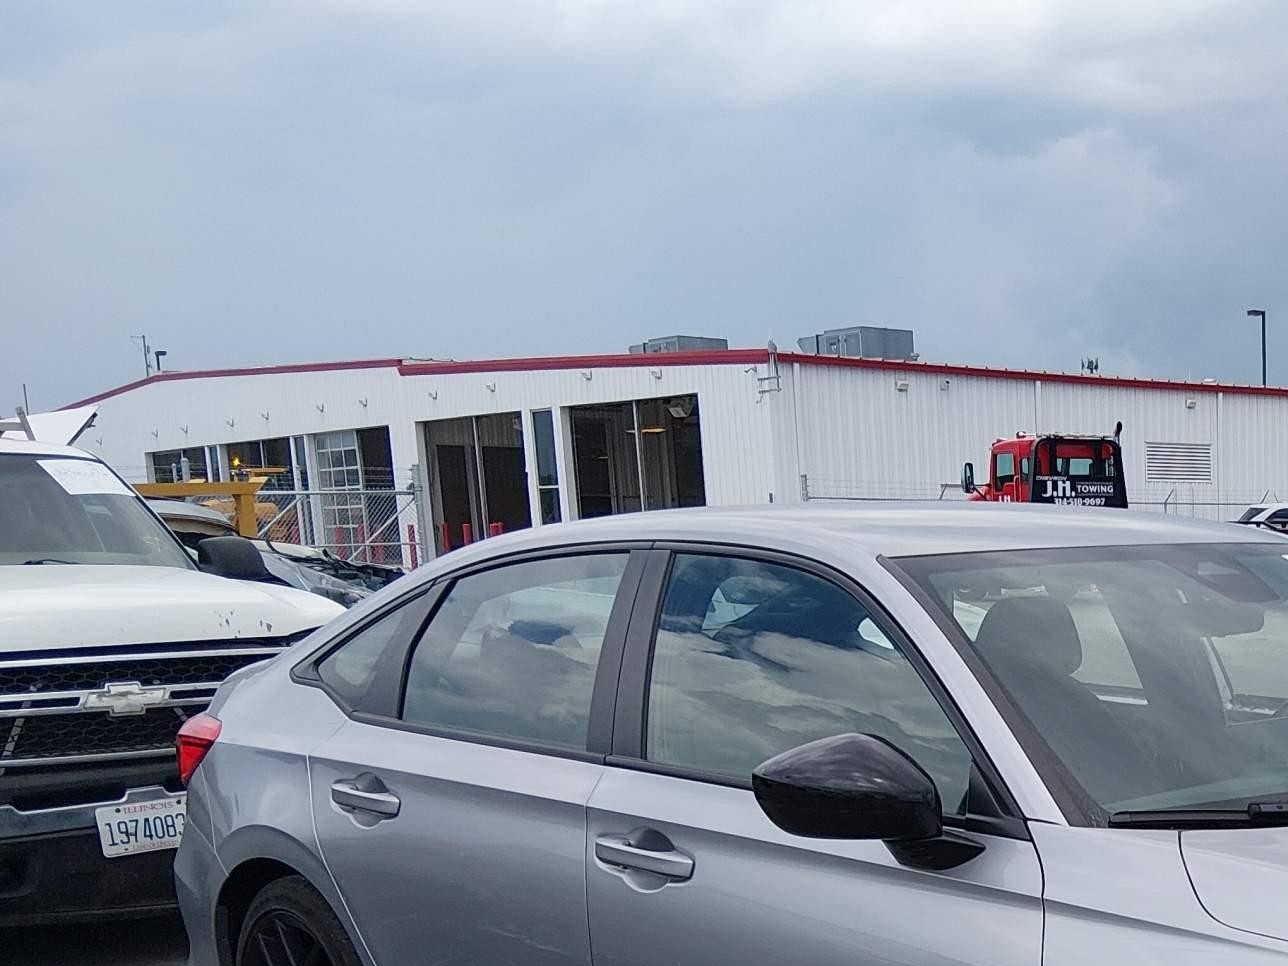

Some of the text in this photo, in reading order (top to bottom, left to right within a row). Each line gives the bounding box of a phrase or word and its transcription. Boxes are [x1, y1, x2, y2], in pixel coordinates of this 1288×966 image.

[1042, 480, 1113, 497] J.H. TOWING
[123, 802, 174, 815] ILLINOIS
